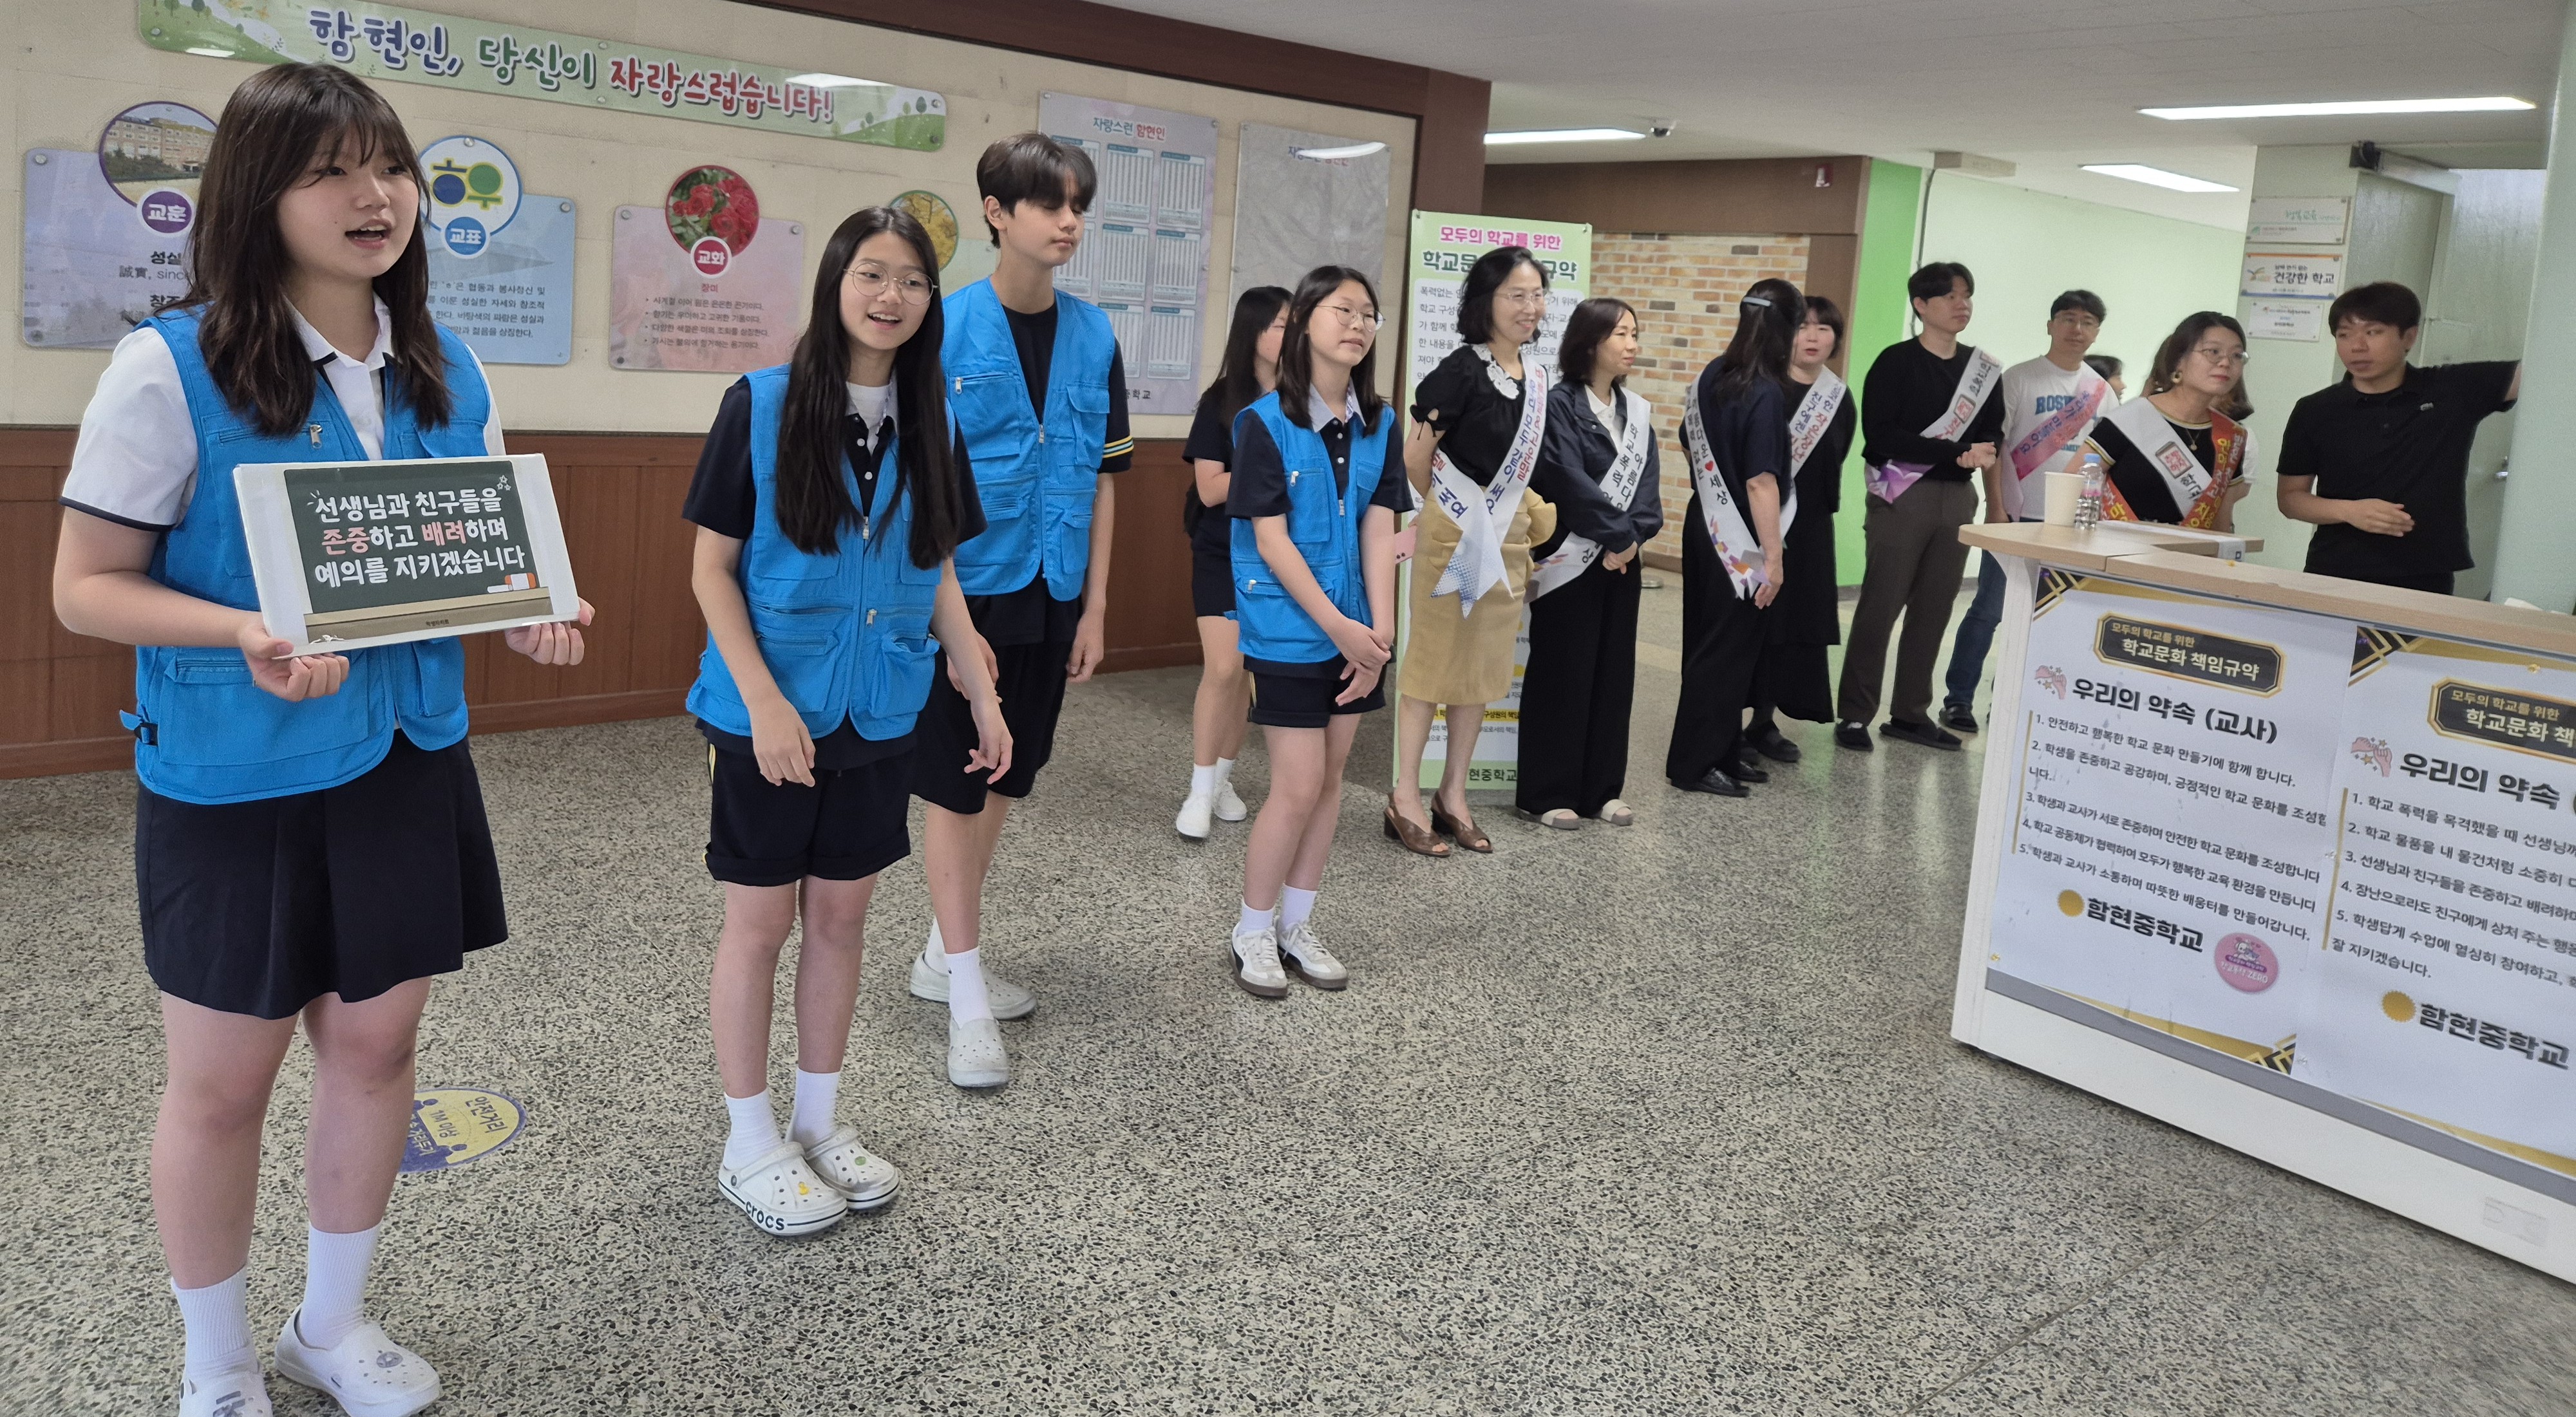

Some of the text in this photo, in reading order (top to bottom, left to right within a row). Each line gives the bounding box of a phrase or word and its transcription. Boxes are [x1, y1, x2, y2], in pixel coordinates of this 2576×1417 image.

[308, 8, 833, 121] 함현인, 당신이 자랑스럽습니다!
[147, 203, 187, 223] 교훈
[450, 228, 482, 245] 교표
[1440, 226, 1482, 244] 모두의
[1533, 234, 1562, 250] 위한
[697, 250, 726, 265] 교화
[2273, 271, 2335, 285] 건강한 학교
[1419, 303, 1436, 314] 학교
[1430, 321, 1447, 332] 함께
[1504, 447, 1524, 484] 같이
[314, 487, 503, 523] 선생님과 친구들을
[1438, 486, 1469, 519] 써요
[1709, 473, 1729, 506] 세상
[321, 517, 509, 556] 존중하고 배려하며
[314, 545, 527, 588] 예의를 지키겠습니다
[2110, 622, 2195, 648] 모두의 학교를 위한
[2122, 638, 2260, 681] 학교문화 책임규약
[2072, 677, 2278, 744] 우리의 약속 (교사)
[2450, 690, 2561, 722] 모두의 학교를 위한
[2466, 708, 2549, 743] 학교문화
[2036, 714, 2297, 787] 1. 안전하고 행복한 학교 문화 만들기에 함께 합니다.
[1468, 767, 1517, 783] 현중학교
[2031, 740, 2288, 817] 2. 학생을 존중하고 공감하며, 긍정적인 학교 문화를
[2400, 752, 2561, 811] 우리의 약속
[2025, 791, 2035, 803] 3.
[2037, 793, 2066, 812] 학생과
[2067, 803, 2099, 821] 교사가
[2099, 812, 2119, 826] 서로
[2121, 817, 2163, 840] 존중하며
[2164, 830, 2198, 850] 안전한
[2200, 840, 2223, 856] 학교
[2224, 847, 2259, 867] 문화를
[2351, 792, 2519, 843] 1. 학교 폭력을 목격했을 때
[2022, 818, 2032, 830] 4.
[2033, 819, 2053, 834] 학교
[2054, 826, 2095, 848] 공동체가
[2096, 838, 2137, 860] 협력하여
[2137, 850, 2171, 870] 모두가
[2172, 859, 2206, 881] 행복한
[2206, 871, 2230, 889] 교육
[2231, 877, 2267, 899] 환경을
[2347, 821, 2360, 836] 2.
[2365, 824, 2392, 843] 학교
[2394, 832, 2436, 855] 물품을
[2439, 845, 2454, 859] 내
[2458, 849, 2515, 875] 물건처럼
[2517, 866, 2563, 887] 소중히
[2018, 843, 2029, 855] 5.
[2032, 845, 2063, 866] 학생과
[2064, 856, 2097, 876] 교사가
[2099, 868, 2143, 890] 소통하며
[2145, 881, 2180, 902] 따뜻한
[2233, 907, 2311, 942] 만들어갑니다.
[2344, 850, 2523, 909] 3. 선생님과 친구들을 존중하고
[2085, 897, 2205, 953] 함현중학교
[2340, 879, 2551, 950] 4. 장난으로라도 친구에게 상처 주는
[2335, 909, 2349, 923] 5.
[2353, 912, 2406, 940] 학생답게
[2409, 929, 2451, 953] 수업에
[2454, 941, 2497, 966] 열심히
[2332, 937, 2432, 979] 잘 지키겠습니다.
[2419, 1002, 2570, 1071] 함현중학교
[437, 1122, 460, 1138] 이상
[465, 1096, 508, 1134] 안전거리
[745, 1201, 785, 1231] crocs
